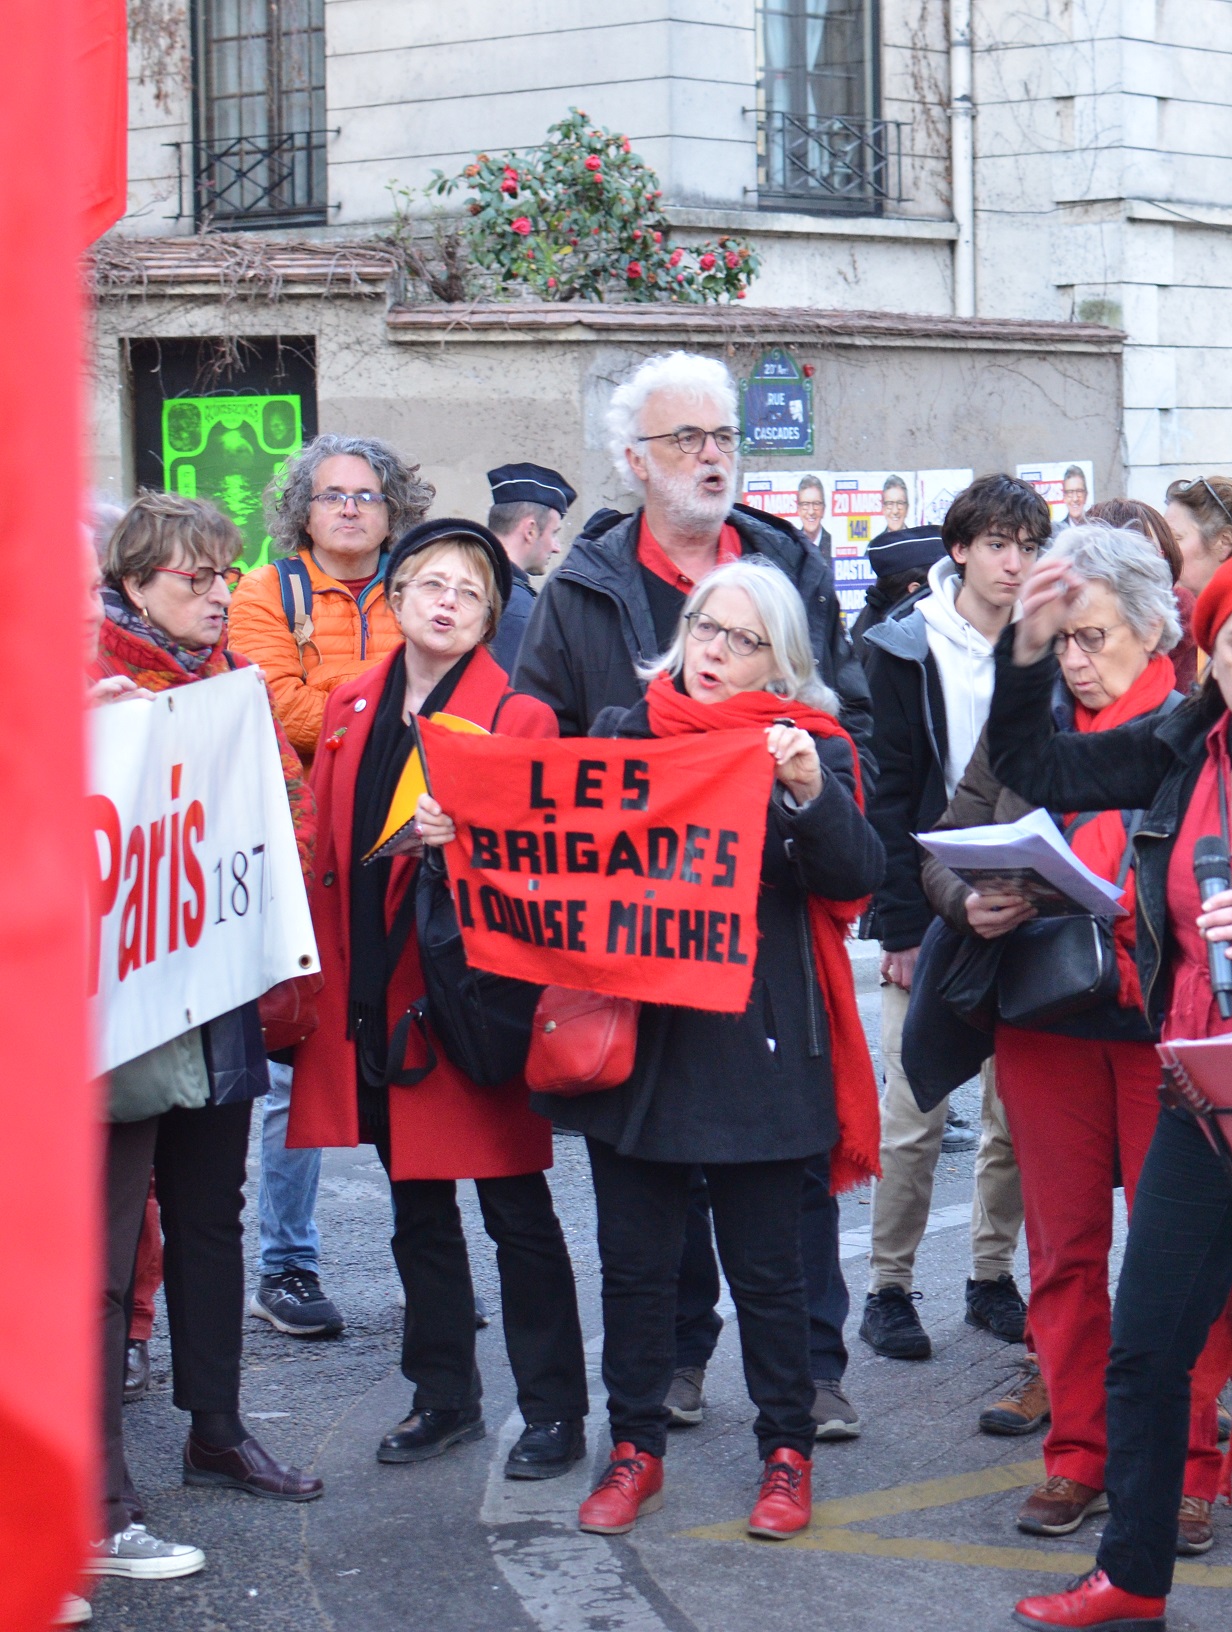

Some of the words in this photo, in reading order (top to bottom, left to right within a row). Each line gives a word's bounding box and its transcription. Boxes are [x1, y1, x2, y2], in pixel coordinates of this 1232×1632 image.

[767, 392, 786, 406] RUE
[754, 426, 800, 440] CASCADES
[763, 493, 798, 514] MARS
[834, 493, 849, 513] 20
[851, 493, 882, 513] MARS
[849, 519, 868, 539] 14H
[529, 759, 650, 811] LES
[86, 763, 206, 1000] Paris
